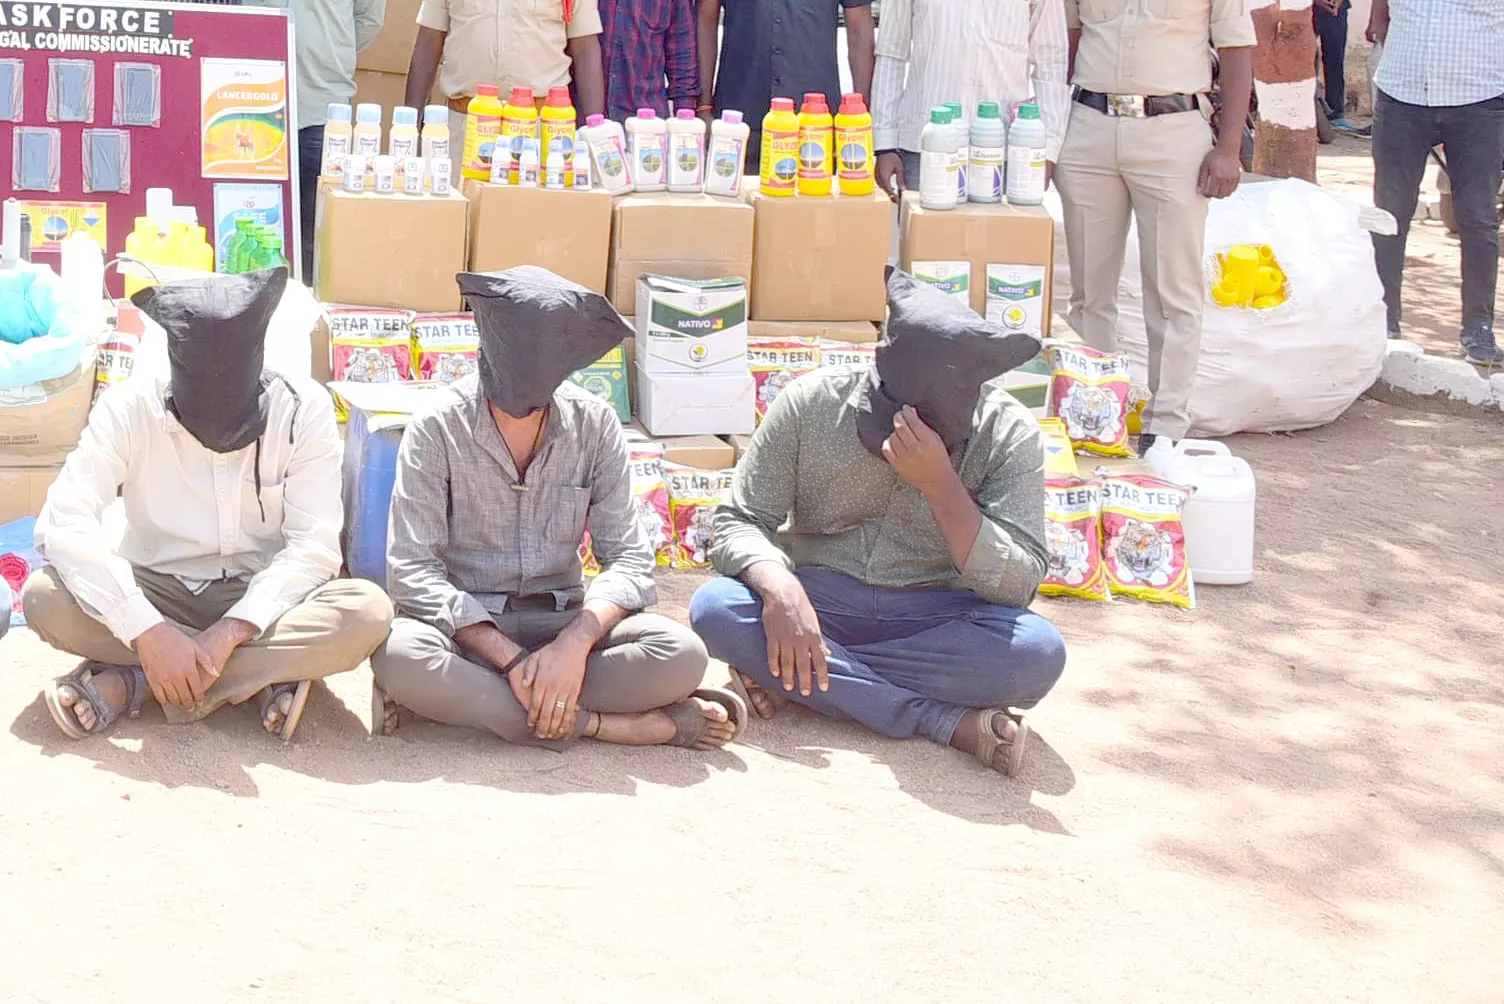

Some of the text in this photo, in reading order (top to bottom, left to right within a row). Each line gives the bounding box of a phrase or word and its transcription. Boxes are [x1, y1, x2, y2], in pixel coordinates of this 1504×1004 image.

[59, 6, 162, 34] FORCE
[34, 31, 192, 57] COMMISSIONERATE
[216, 91, 278, 101] LANCERGOLD
[998, 286, 1025, 294] NATIVO
[333, 317, 409, 332] STAR TEEN
[415, 323, 479, 339] STAR TEE
[678, 319, 711, 329] NATIVO
[747, 350, 813, 363] STAR TEEN
[828, 353, 861, 366] STAR
[1055, 349, 1128, 373] STAR TEEN
[672, 475, 709, 491] STAR
[1056, 489, 1098, 506] TEEN
[1102, 483, 1140, 504] STAR
